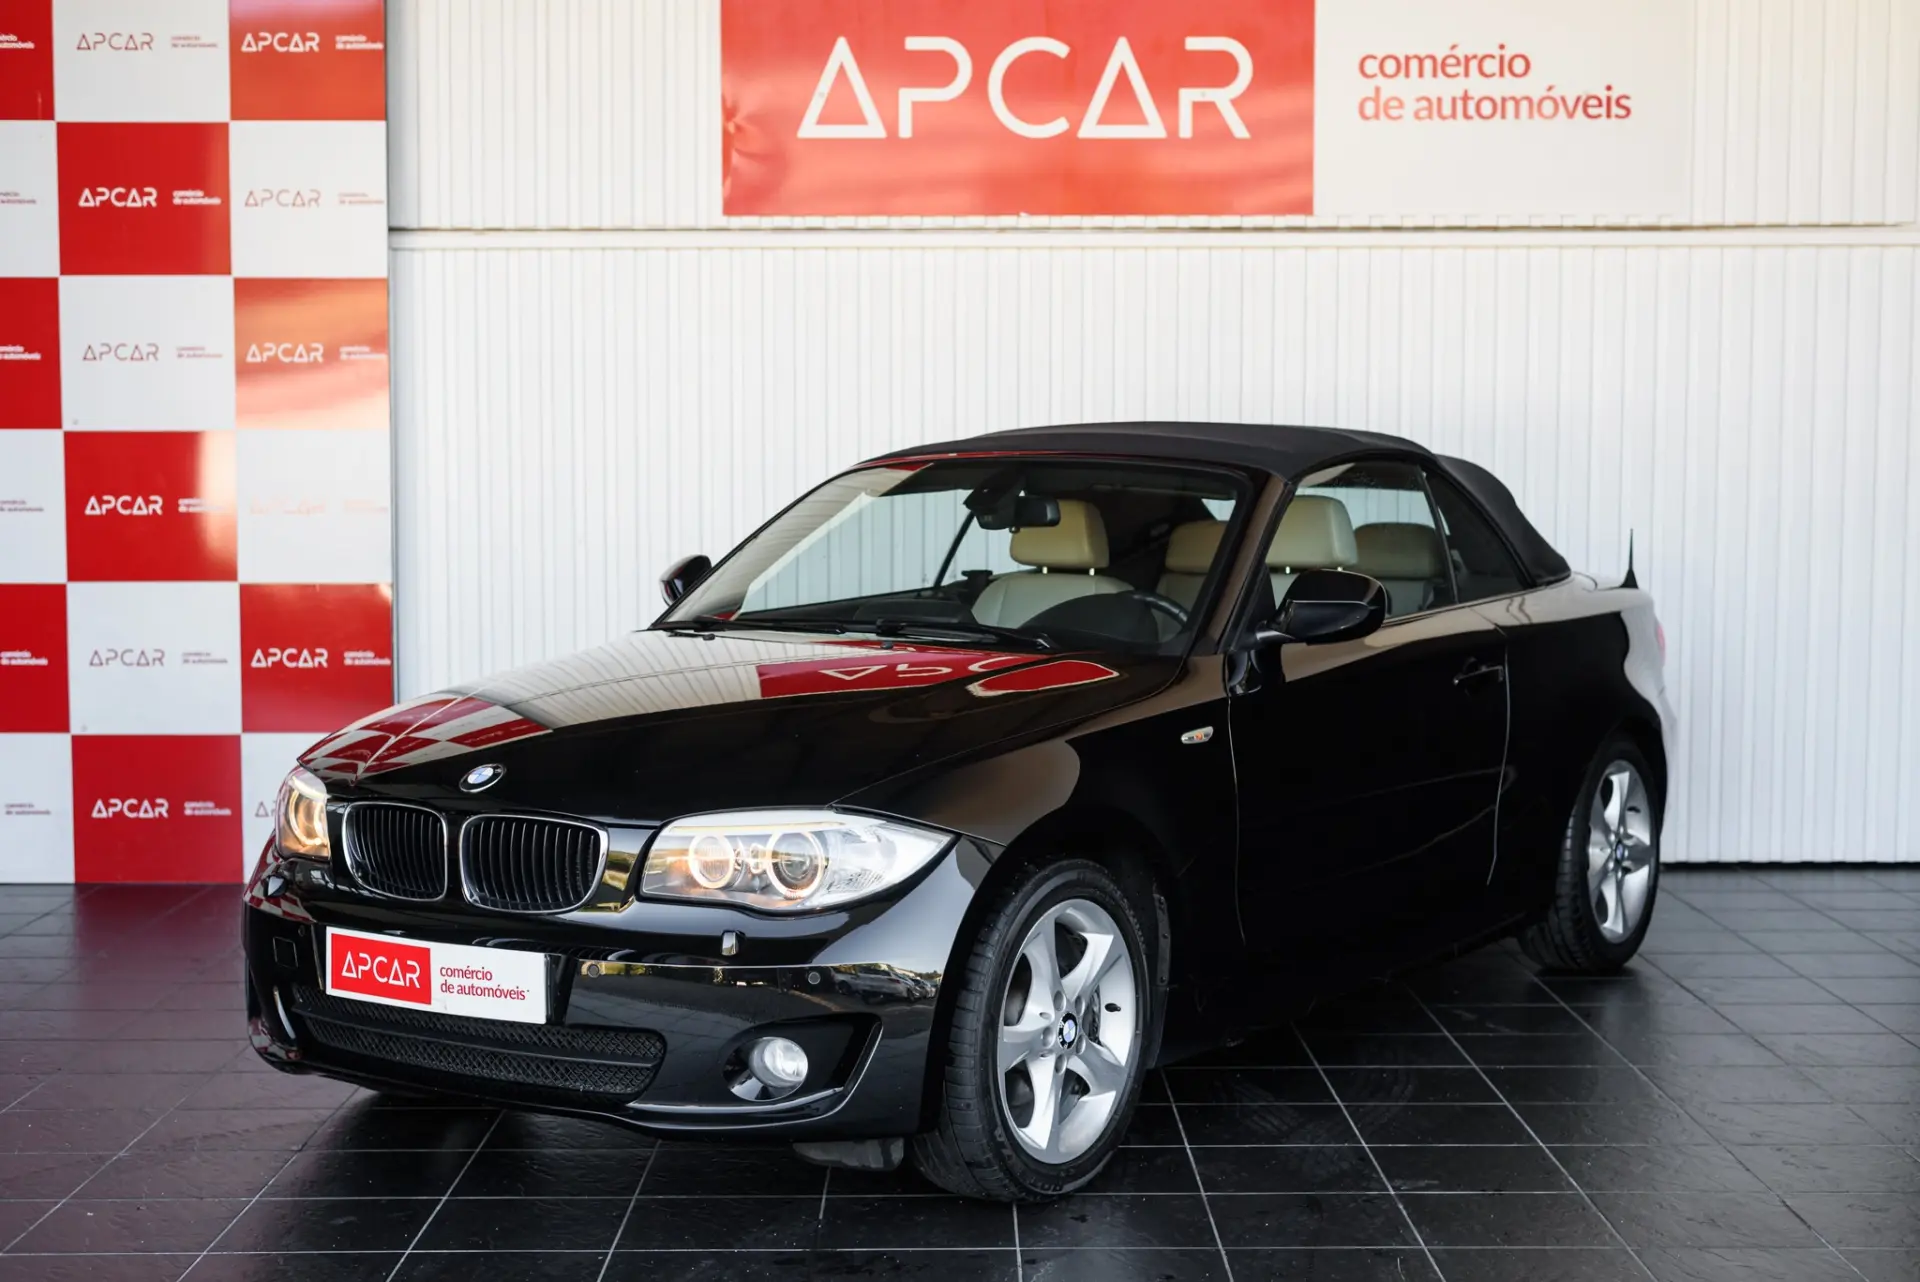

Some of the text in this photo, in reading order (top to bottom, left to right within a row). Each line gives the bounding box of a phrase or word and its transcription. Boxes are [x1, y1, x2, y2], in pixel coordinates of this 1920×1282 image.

[76, 33, 154, 50] APCAR
[241, 32, 320, 53] APCAR
[1358, 44, 1531, 80] comércio
[797, 36, 1255, 139] APCAR
[1358, 84, 1632, 121] de automóveis
[79, 187, 158, 208] APCAR
[245, 189, 321, 208] APCAR
[82, 343, 160, 361] APCAR
[246, 343, 324, 363] APCAR
[85, 495, 163, 516] APCAR
[89, 648, 166, 667] APCAR
[251, 648, 328, 669] APCAR
[92, 798, 168, 819] APCAR
[341, 950, 421, 989] APCAR
[440, 965, 493, 981] comércio
[440, 979, 526, 1000] de automóveis
